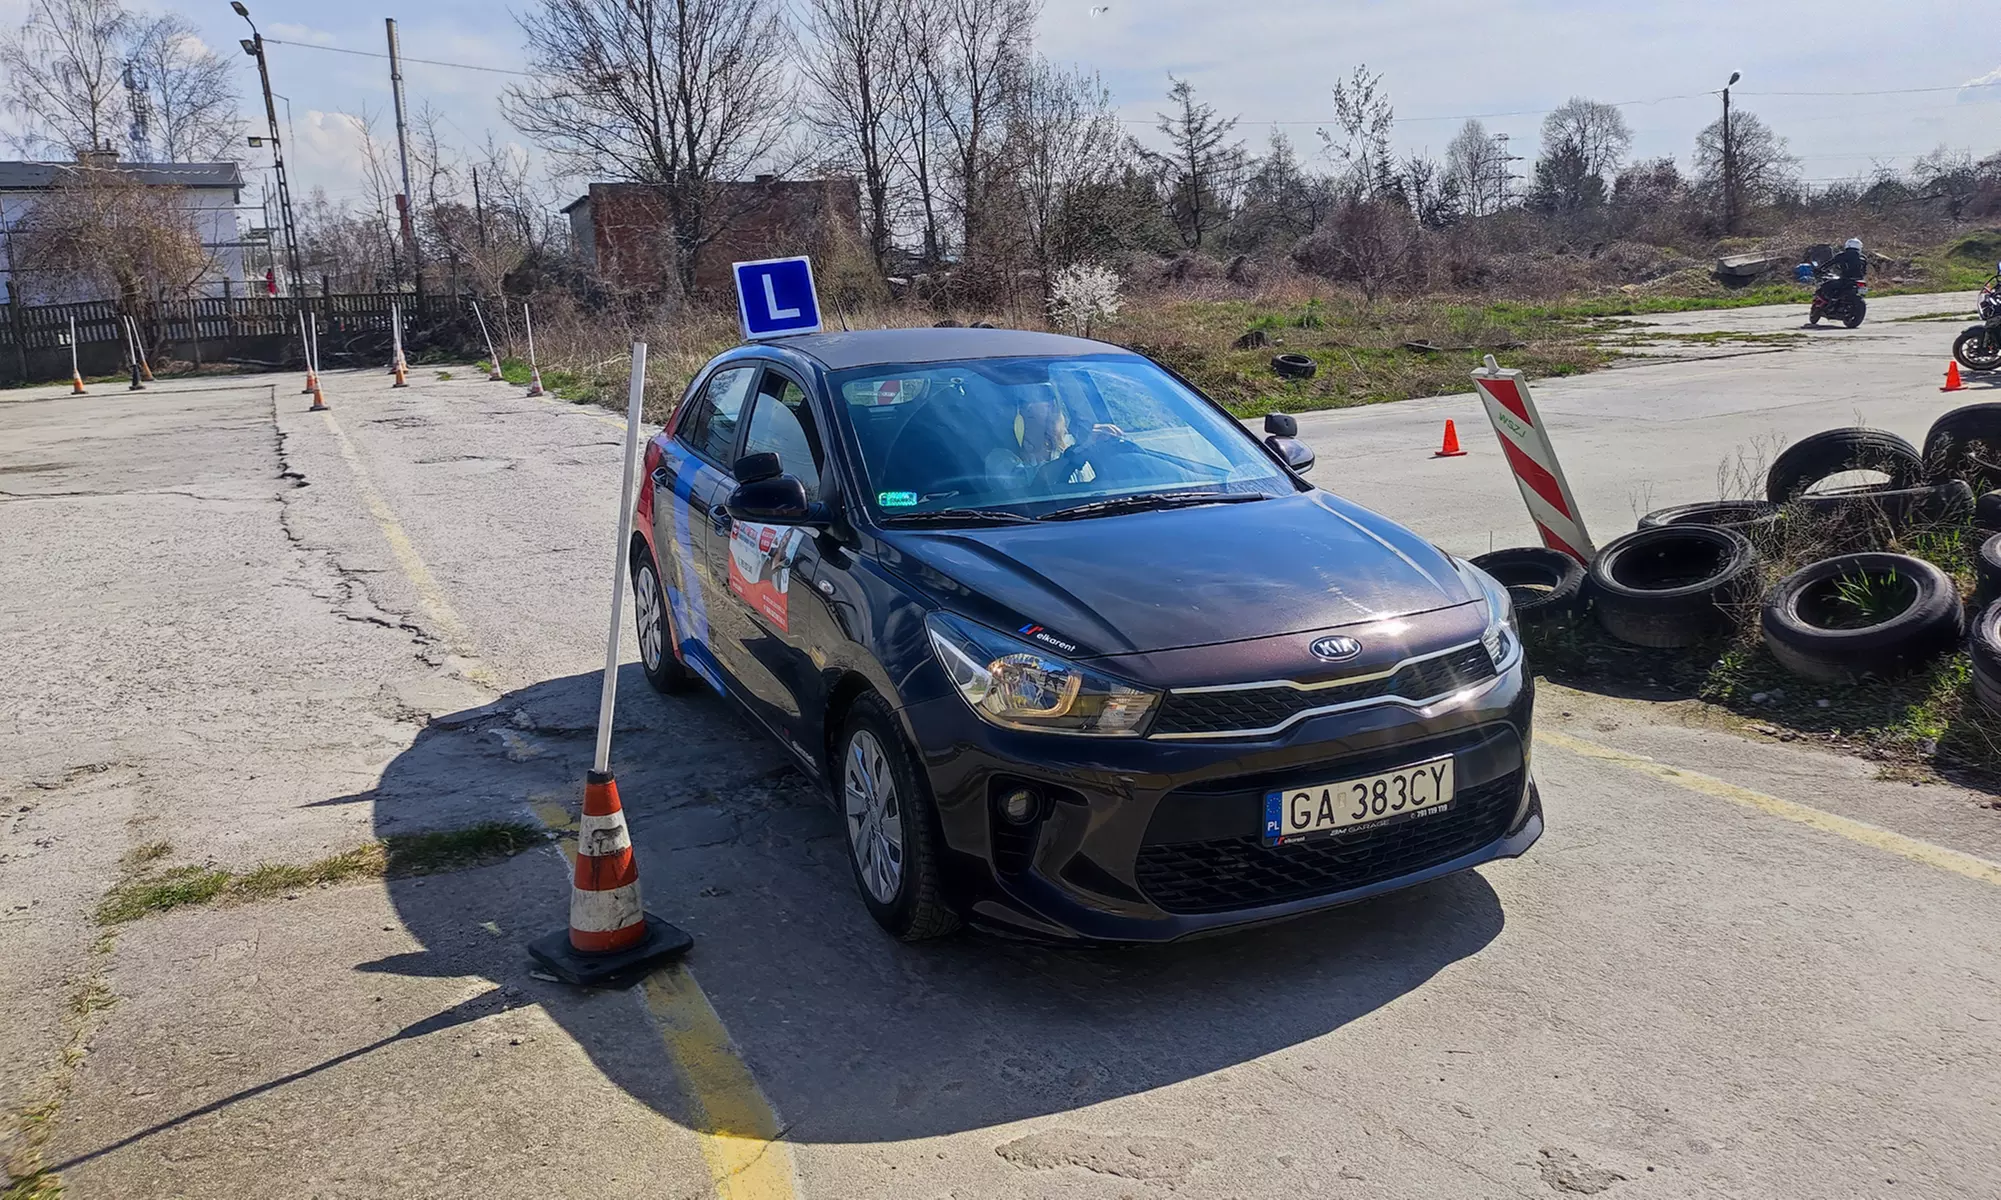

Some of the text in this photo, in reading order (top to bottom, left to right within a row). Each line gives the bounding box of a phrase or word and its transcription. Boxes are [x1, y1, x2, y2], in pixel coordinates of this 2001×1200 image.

[762, 273, 800, 320] L
[1036, 632, 1076, 652] elkarent
[1317, 638, 1355, 656] KIA
[1290, 763, 1446, 830] GA 383CY
[1267, 821, 1279, 832] PL
